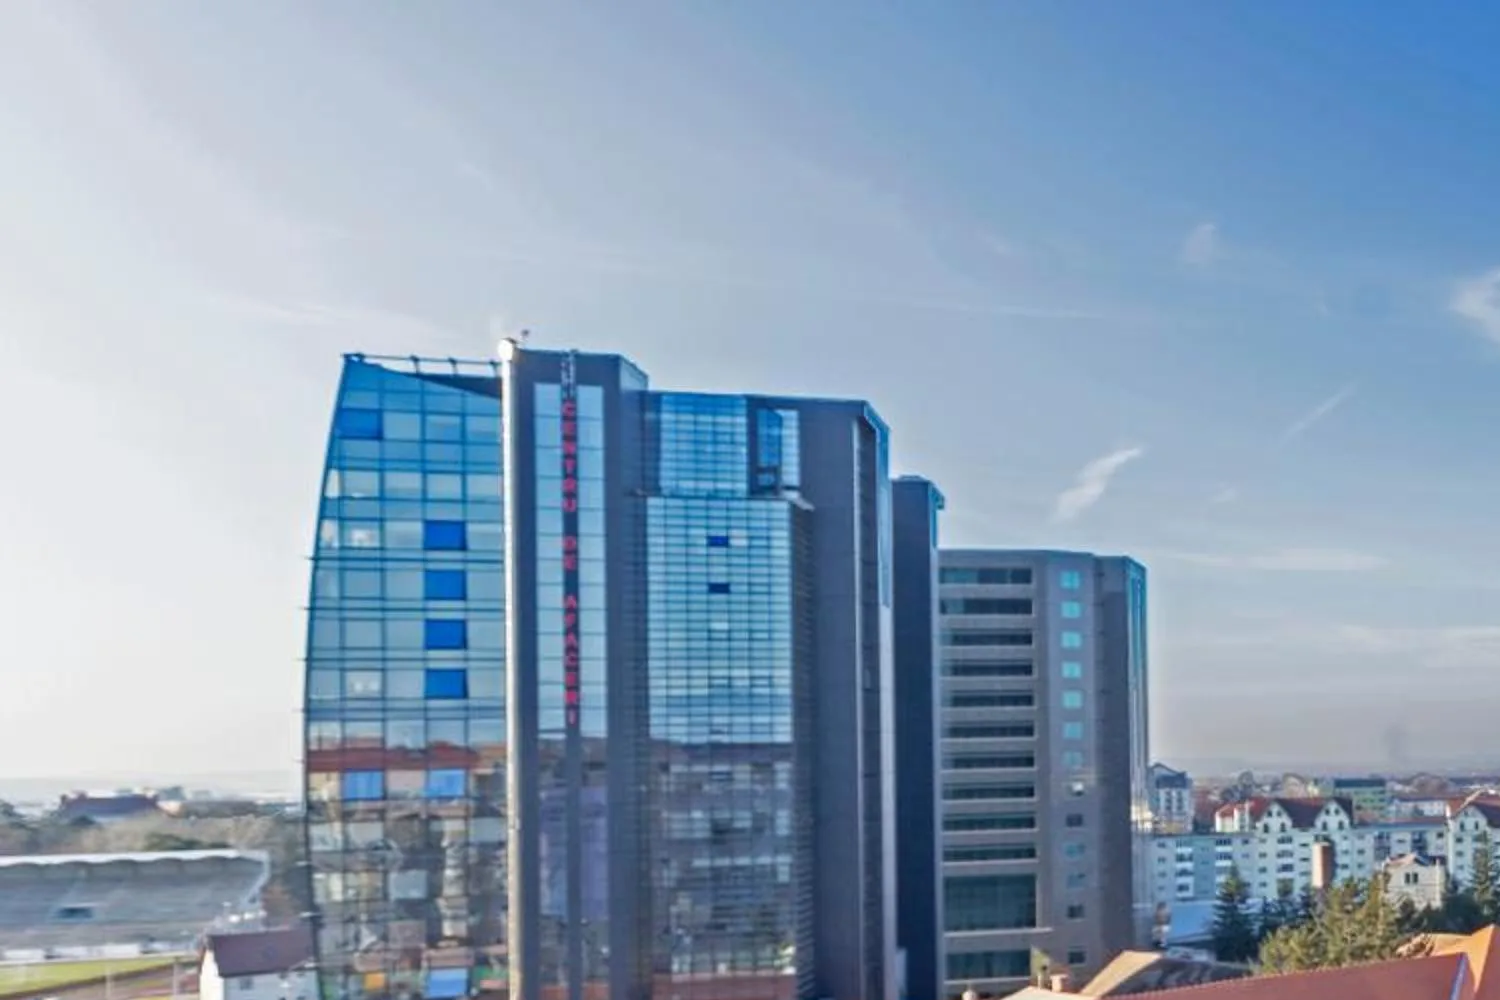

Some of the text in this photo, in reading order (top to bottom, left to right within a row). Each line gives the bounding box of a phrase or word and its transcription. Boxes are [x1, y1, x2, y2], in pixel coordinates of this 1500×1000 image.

[561, 400, 578, 513] CENTRU
[562, 536, 577, 572] DE
[563, 595, 579, 725] AFACERI
